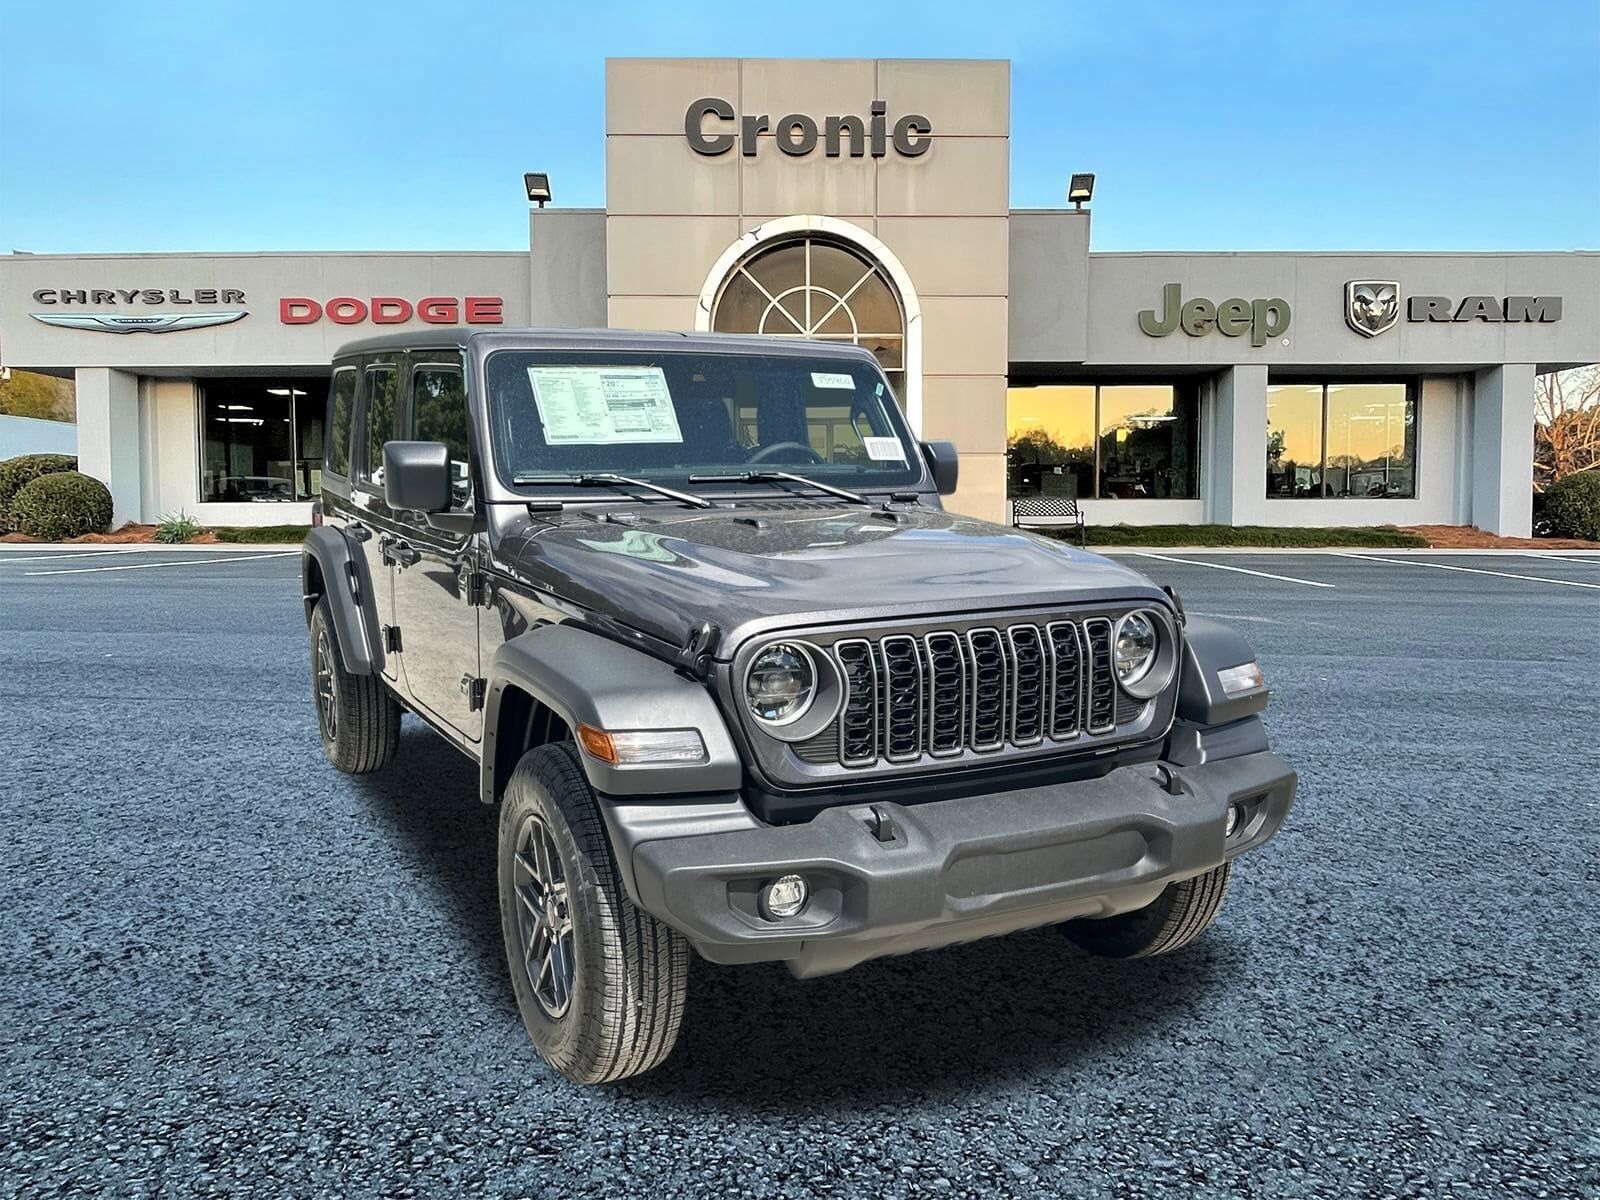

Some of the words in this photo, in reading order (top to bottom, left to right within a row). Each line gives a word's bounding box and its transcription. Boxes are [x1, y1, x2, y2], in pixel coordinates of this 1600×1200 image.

[684, 97, 933, 158] Cronic
[32, 288, 247, 305] CHRYSLER
[1407, 296, 1563, 323] RAM
[279, 297, 504, 325] DODGE
[1138, 283, 1292, 347] Jeep
